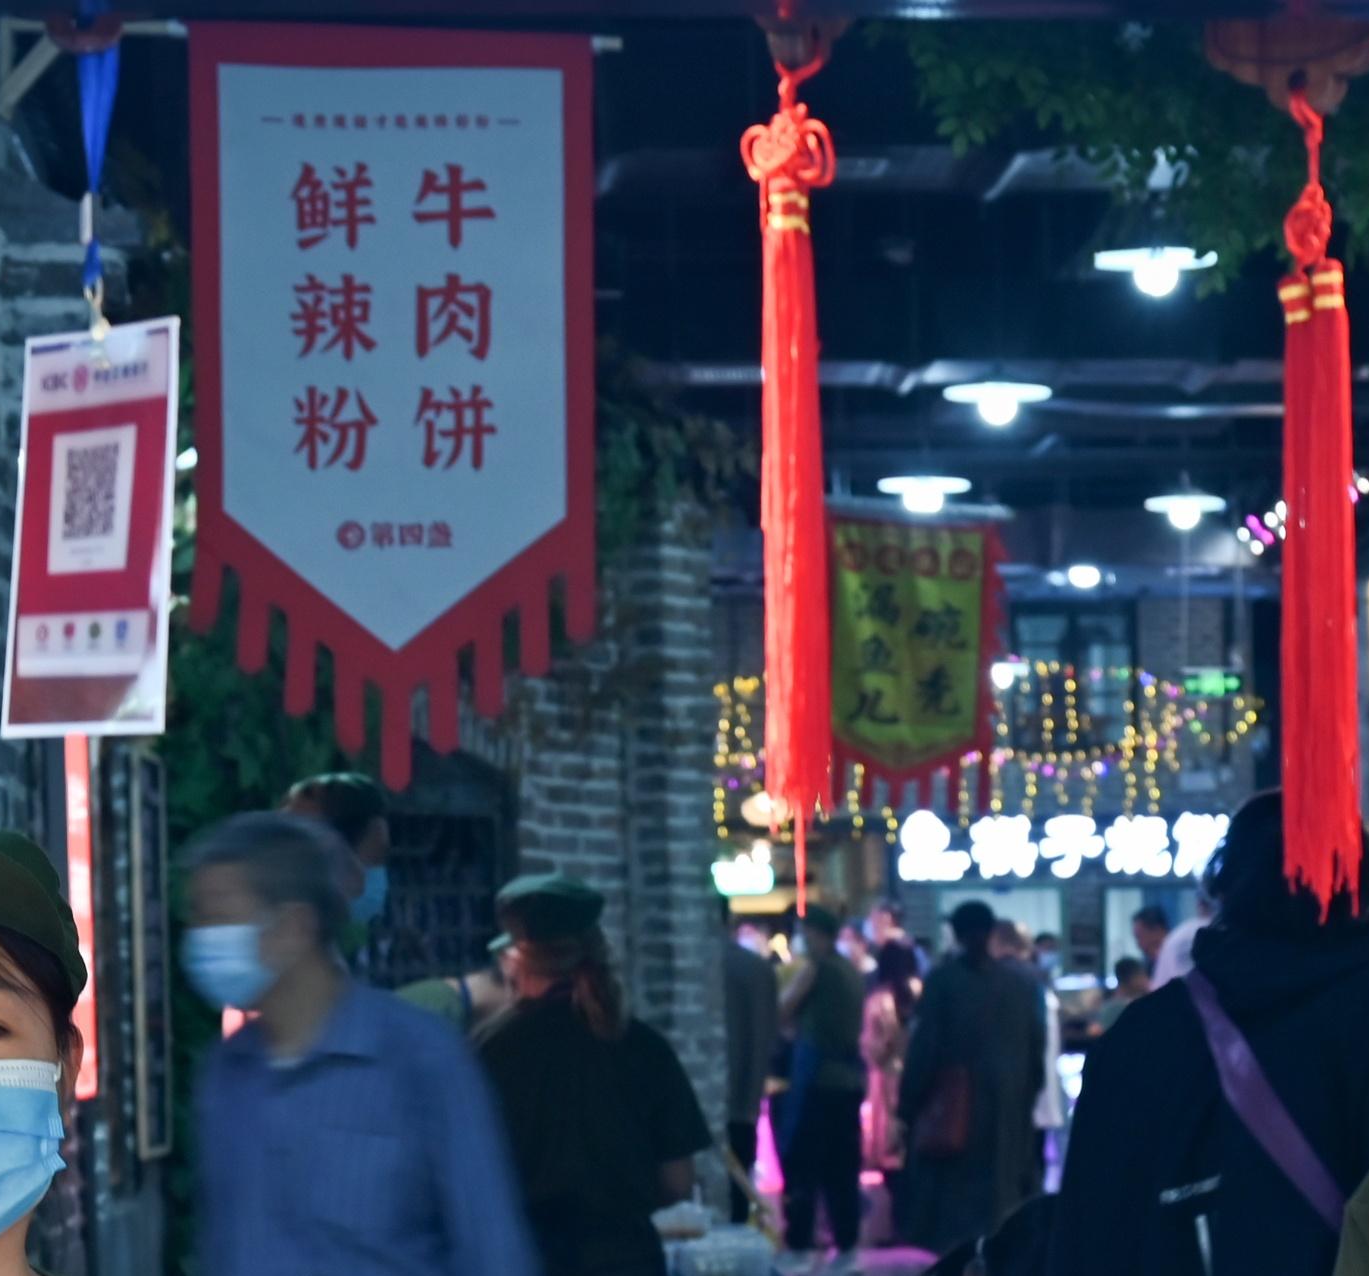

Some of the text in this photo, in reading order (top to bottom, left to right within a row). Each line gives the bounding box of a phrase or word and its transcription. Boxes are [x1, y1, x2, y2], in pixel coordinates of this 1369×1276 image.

[288, 161, 378, 471] 鲜辣粉
[410, 163, 497, 472] 牛肉饼
